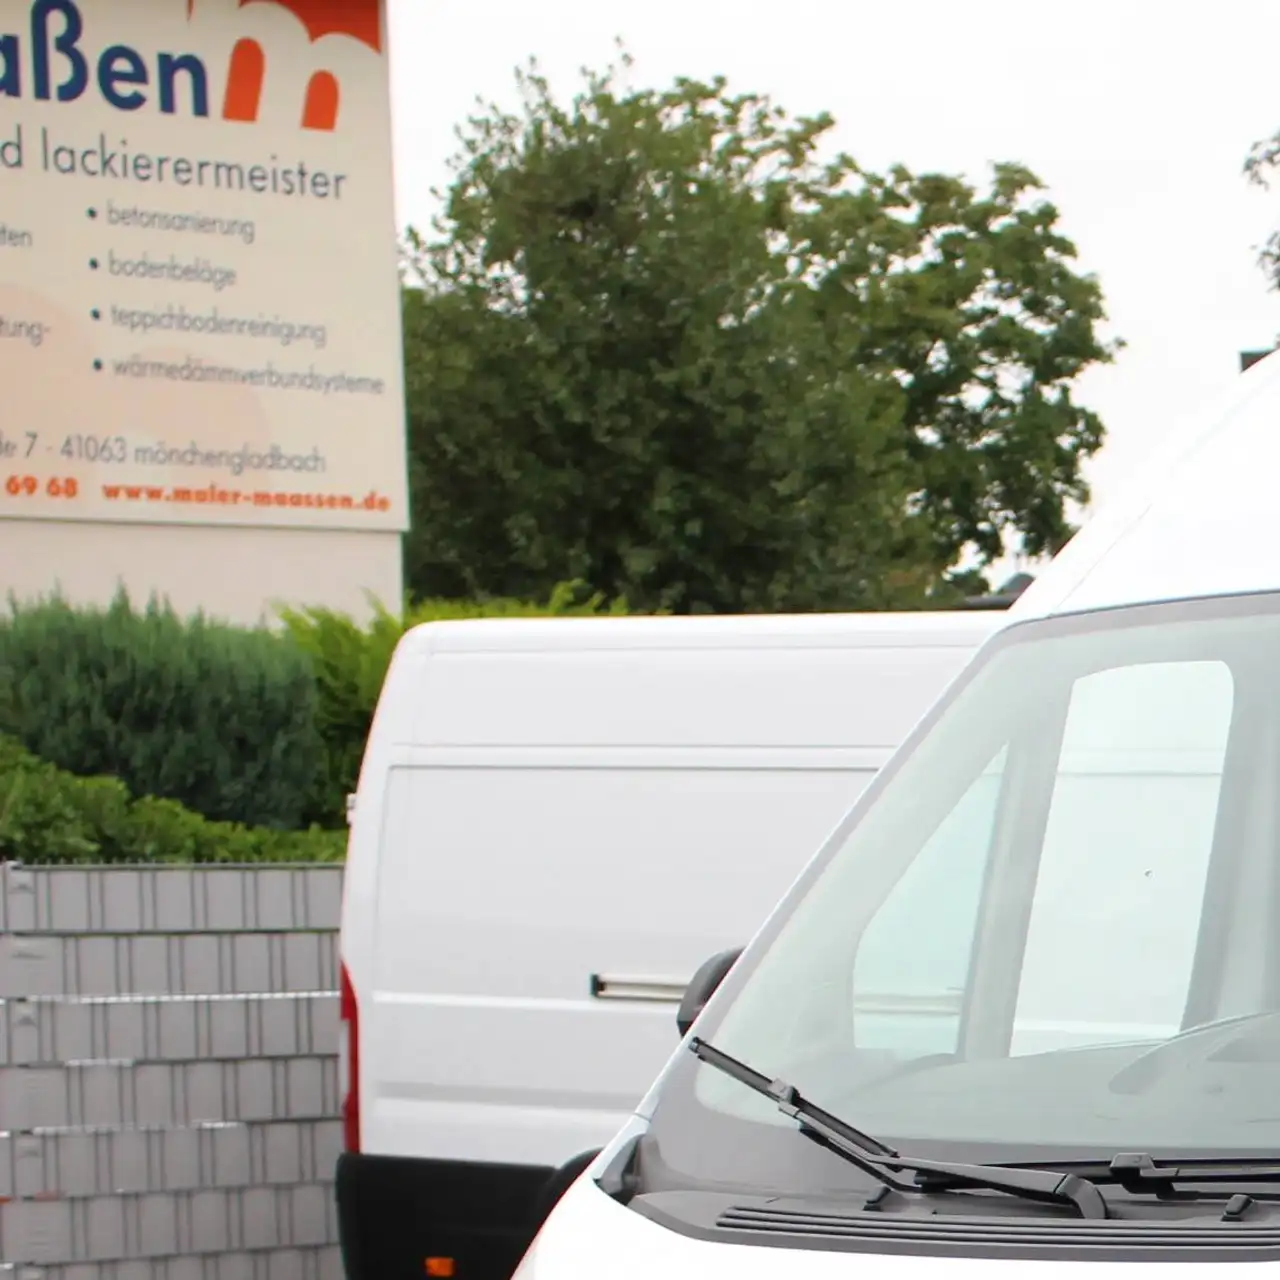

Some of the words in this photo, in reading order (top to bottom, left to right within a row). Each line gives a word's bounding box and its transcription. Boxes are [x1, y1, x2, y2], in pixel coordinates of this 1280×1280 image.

[41, 125, 348, 199] lackierermeister
[107, 200, 256, 245] betonsanierung
[108, 249, 237, 291] bodenbeläge
[111, 304, 327, 349] teppichbodenreinigung
[113, 354, 385, 395] wärmedämmverbundsysteme
[25, 431, 38, 458] 7
[60, 434, 127, 463] 41063
[134, 440, 327, 477] mönchengladbach
[6, 474, 38, 497] 69
[46, 476, 79, 499] 68
[102, 481, 391, 512] www.maler-maassen.de
